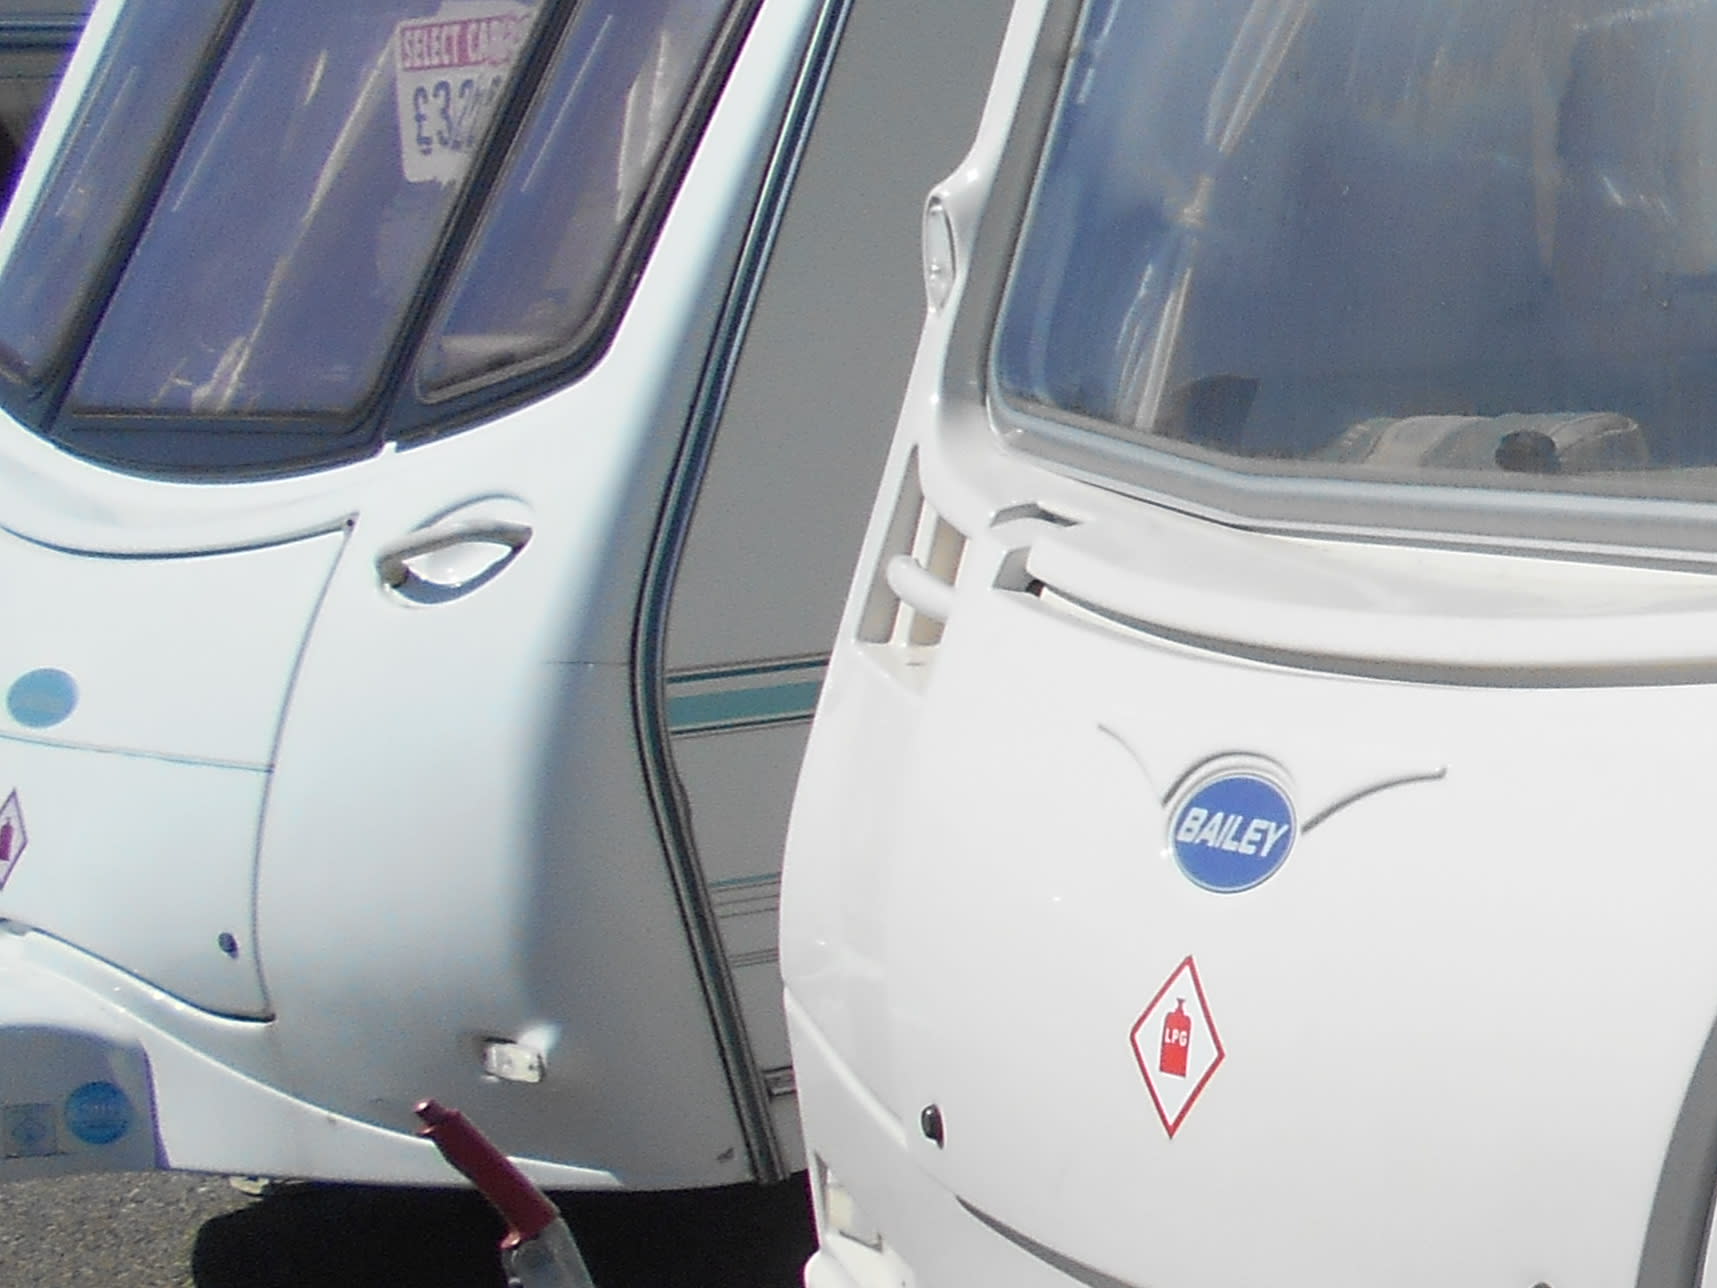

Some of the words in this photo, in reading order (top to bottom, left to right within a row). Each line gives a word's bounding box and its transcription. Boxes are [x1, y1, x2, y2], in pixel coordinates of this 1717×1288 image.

[403, 23, 461, 69] SELECT
[1176, 806, 1289, 858] BAILEY
[1164, 1027, 1188, 1048] LPG
